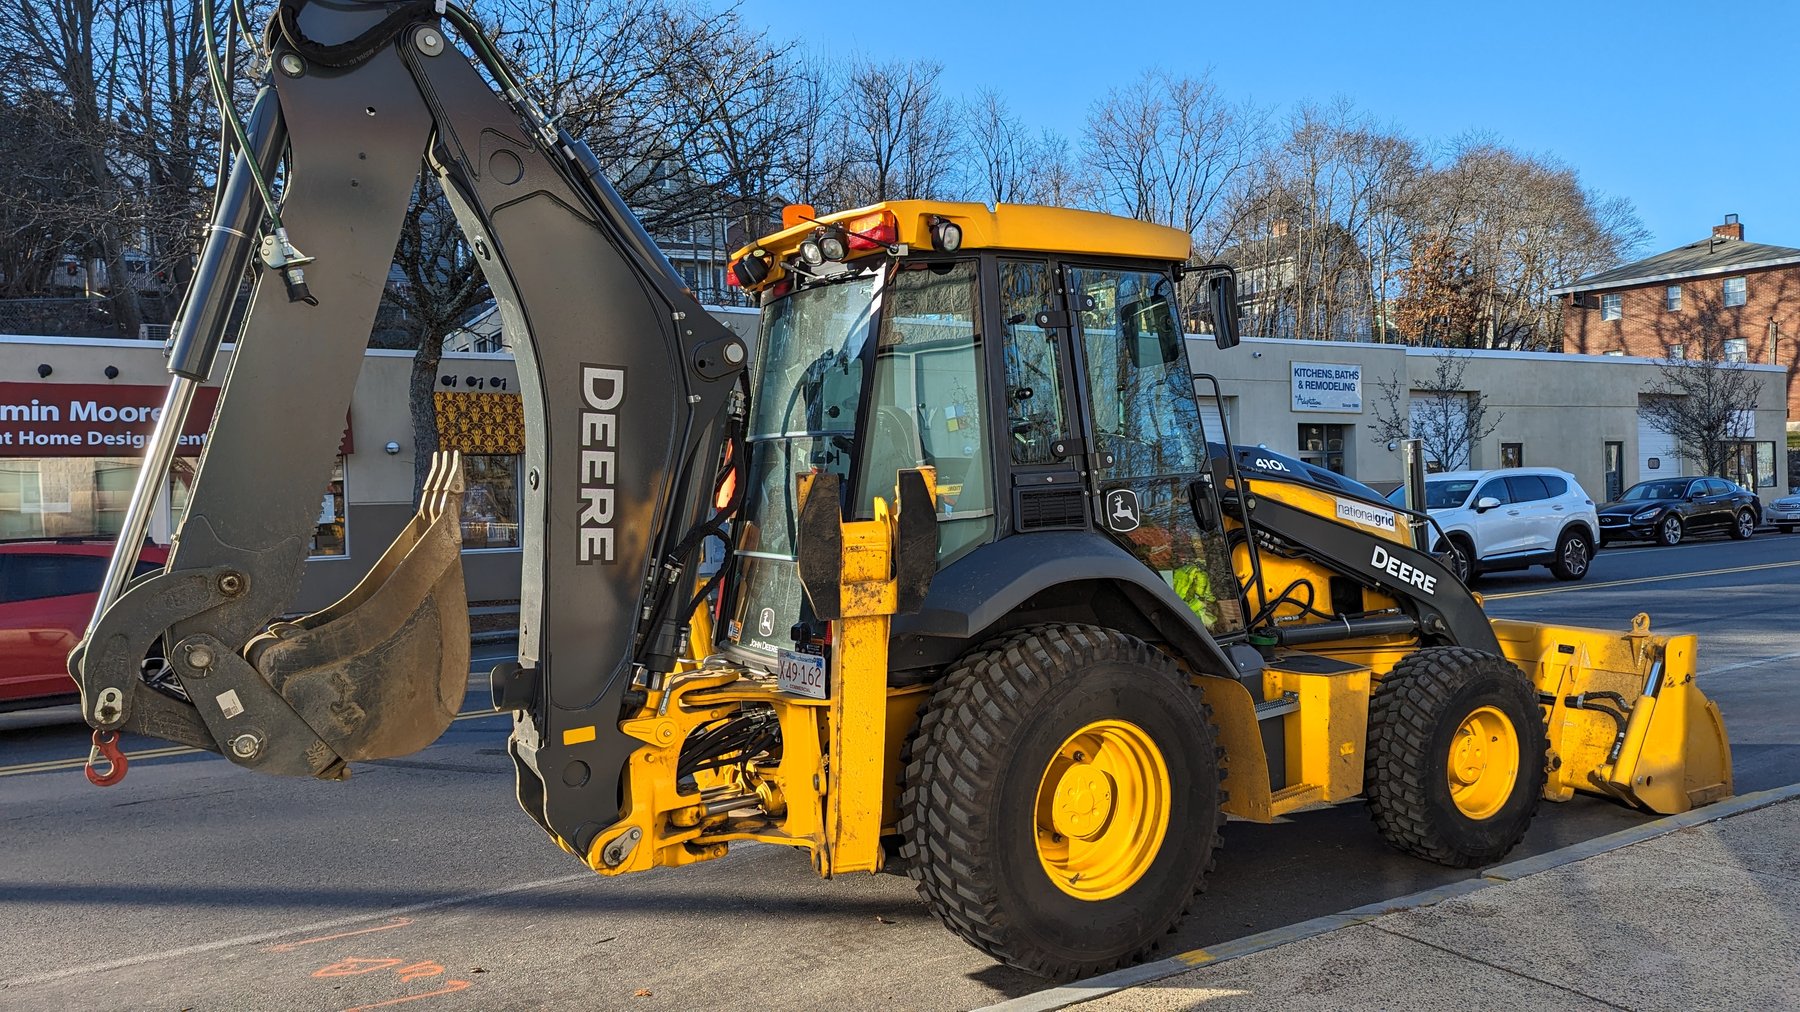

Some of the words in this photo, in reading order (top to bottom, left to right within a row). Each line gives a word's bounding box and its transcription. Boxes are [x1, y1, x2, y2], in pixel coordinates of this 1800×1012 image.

[1298, 380, 1303, 389] &
[1305, 381, 1356, 392] REMODELING
[69, 401, 162, 422] Moore
[0, 432, 12, 445] t
[18, 431, 82, 445] Home
[580, 366, 625, 561] DEERE
[1255, 458, 1290, 472] 410L
[1371, 545, 1437, 595] DEERE
[750, 639, 762, 649] JOHN
[762, 641, 778, 653] DEERE
